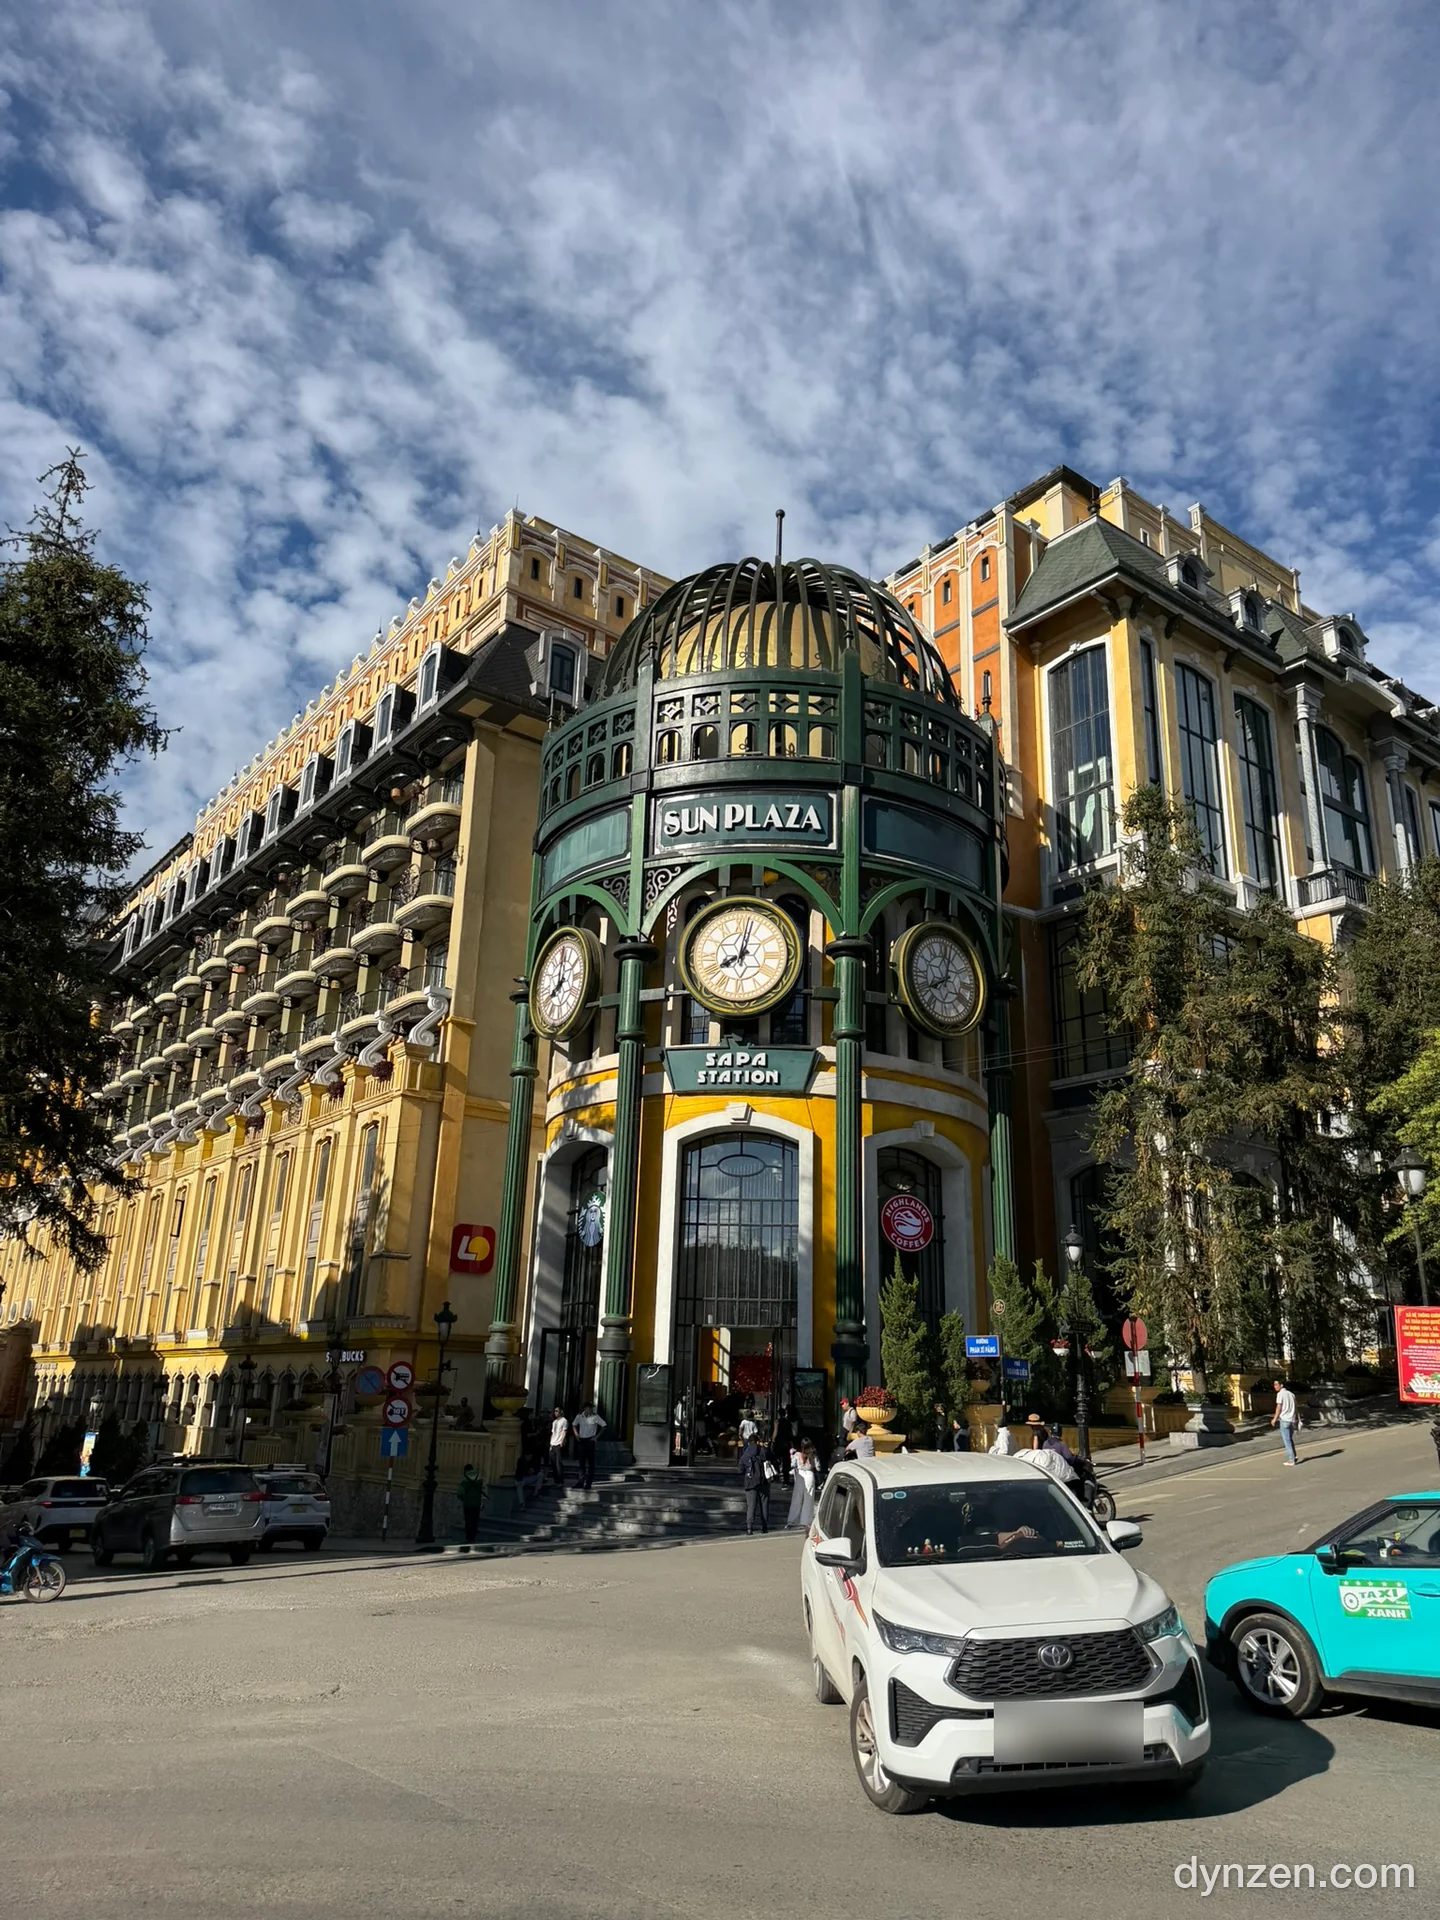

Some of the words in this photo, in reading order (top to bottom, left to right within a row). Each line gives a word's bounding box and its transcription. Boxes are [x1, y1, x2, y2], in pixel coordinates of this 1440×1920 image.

[664, 805, 718, 836] SUN
[724, 803, 823, 831] PLAZA
[705, 1052, 767, 1067] SAPA
[697, 1069, 779, 1084] STATION
[885, 1198, 930, 1223] HIGHLANDS
[890, 1232, 925, 1249] COFFEE
[326, 1350, 364, 1362] SBUCKS
[1359, 1588, 1399, 1599] TAXI
[1366, 1608, 1407, 1618] XANH
